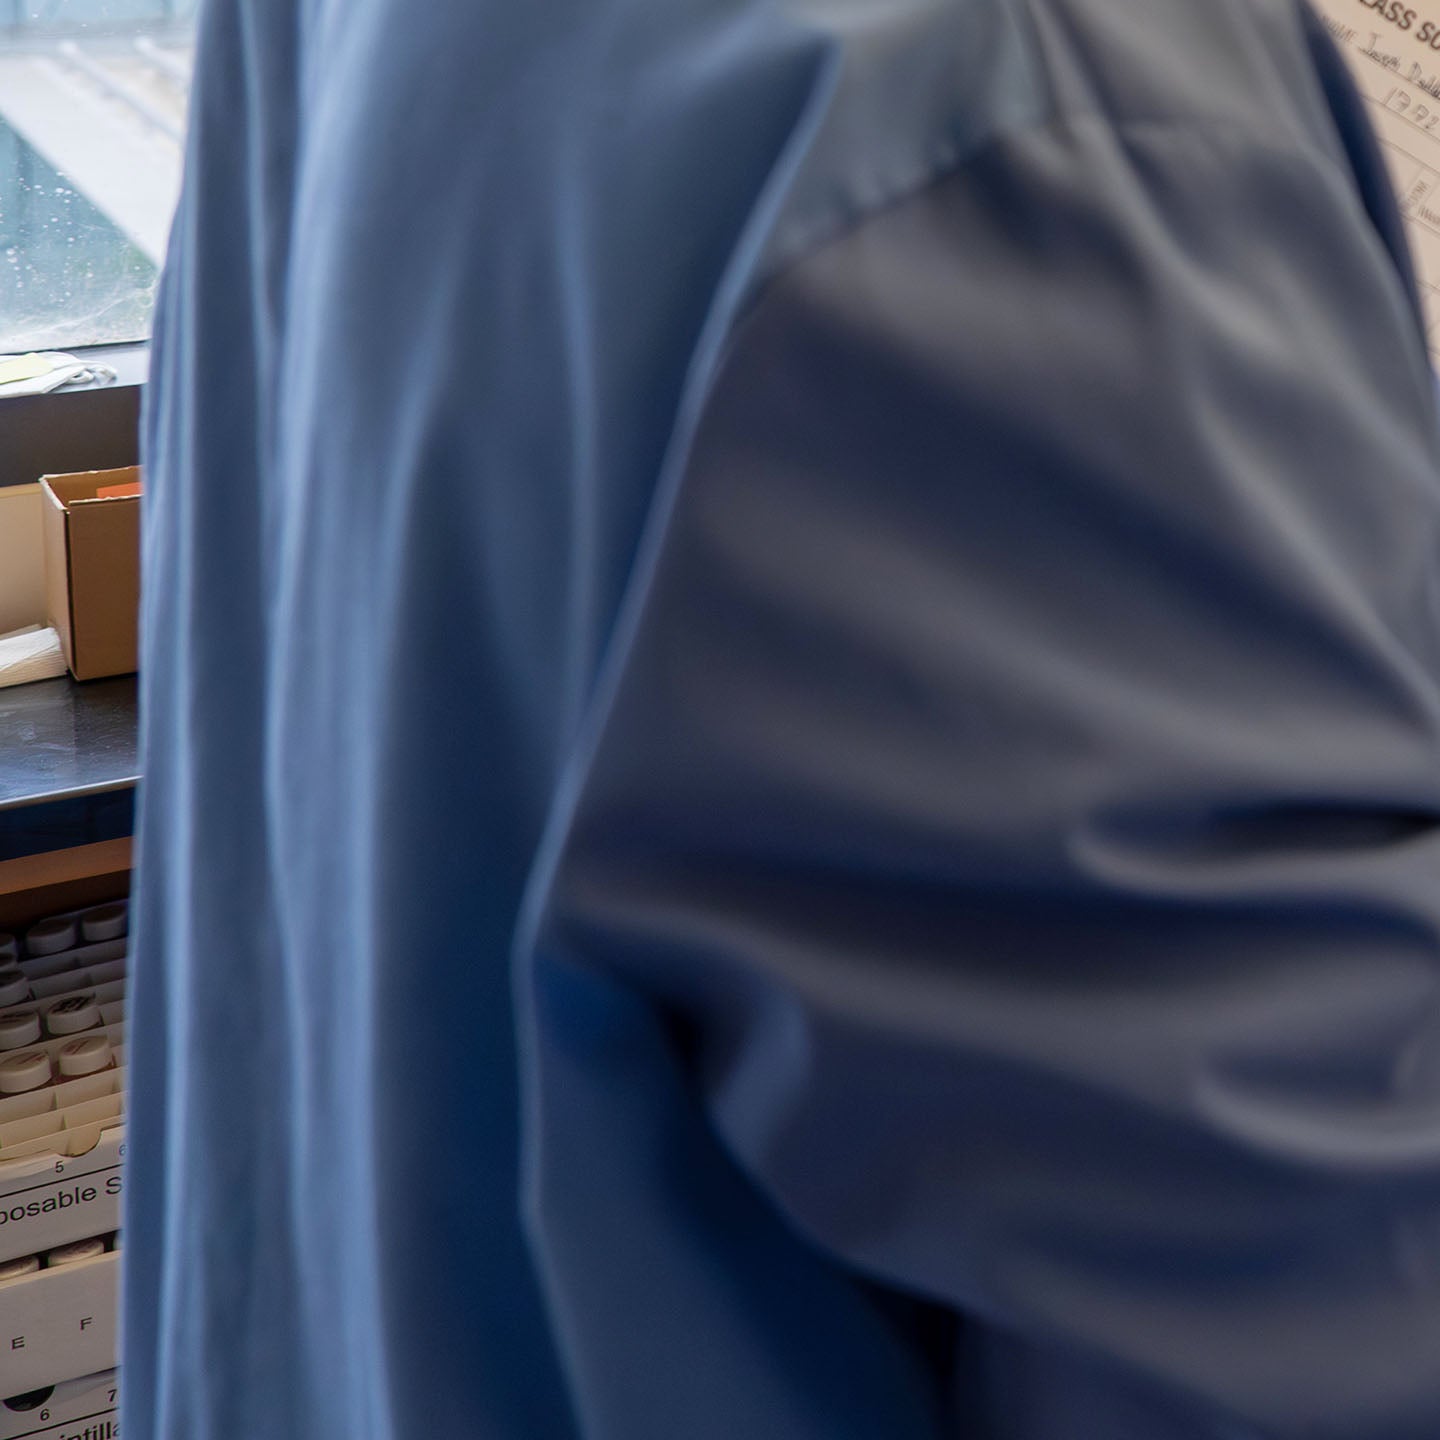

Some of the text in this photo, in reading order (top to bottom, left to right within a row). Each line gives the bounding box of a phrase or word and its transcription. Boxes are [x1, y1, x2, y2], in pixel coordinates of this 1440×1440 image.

[54, 1160, 65, 1174] 5
[11, 1317, 93, 1350] E F
[39, 1408, 50, 1422] 6
